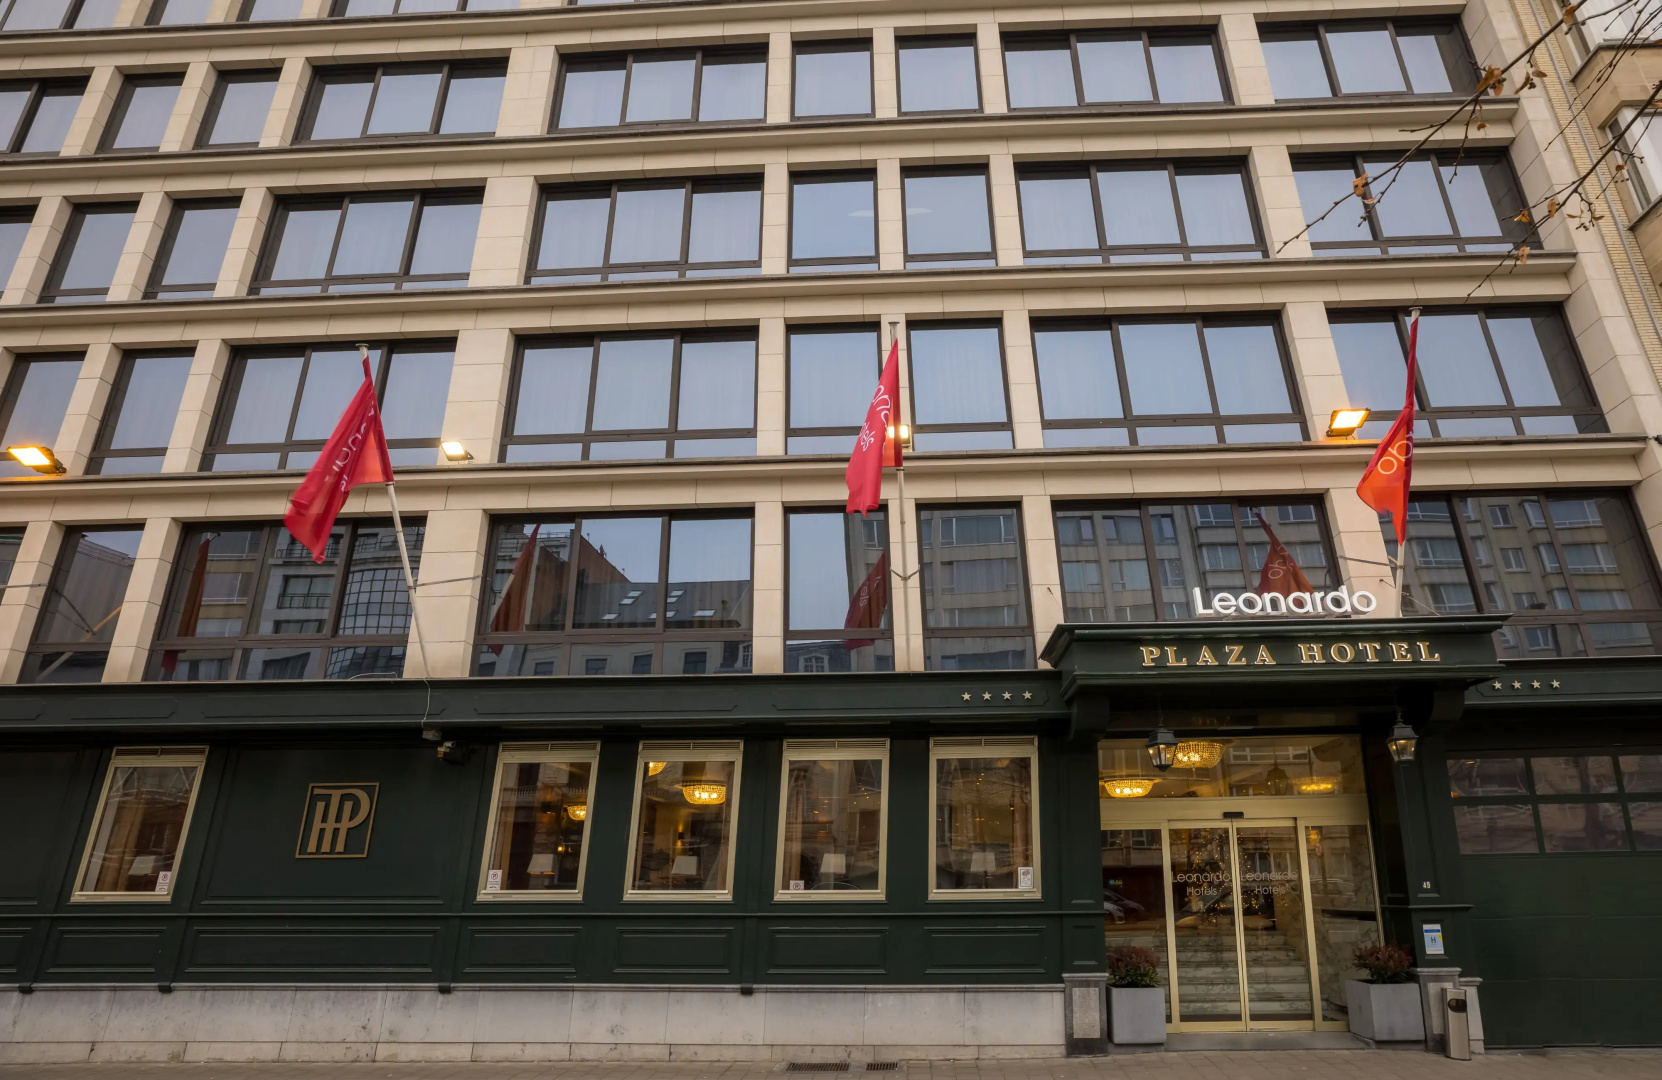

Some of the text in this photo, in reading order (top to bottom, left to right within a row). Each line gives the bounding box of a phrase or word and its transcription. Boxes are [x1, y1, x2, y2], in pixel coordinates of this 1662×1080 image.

[1193, 585, 1377, 615] Leonardo
[1140, 642, 1441, 666] PLAZA HOTEL
[1171, 871, 1231, 882] Leonardo
[1241, 870, 1298, 882] Leonardo
[1186, 886, 1218, 896] Hotels
[1255, 885, 1286, 895] Hotels
